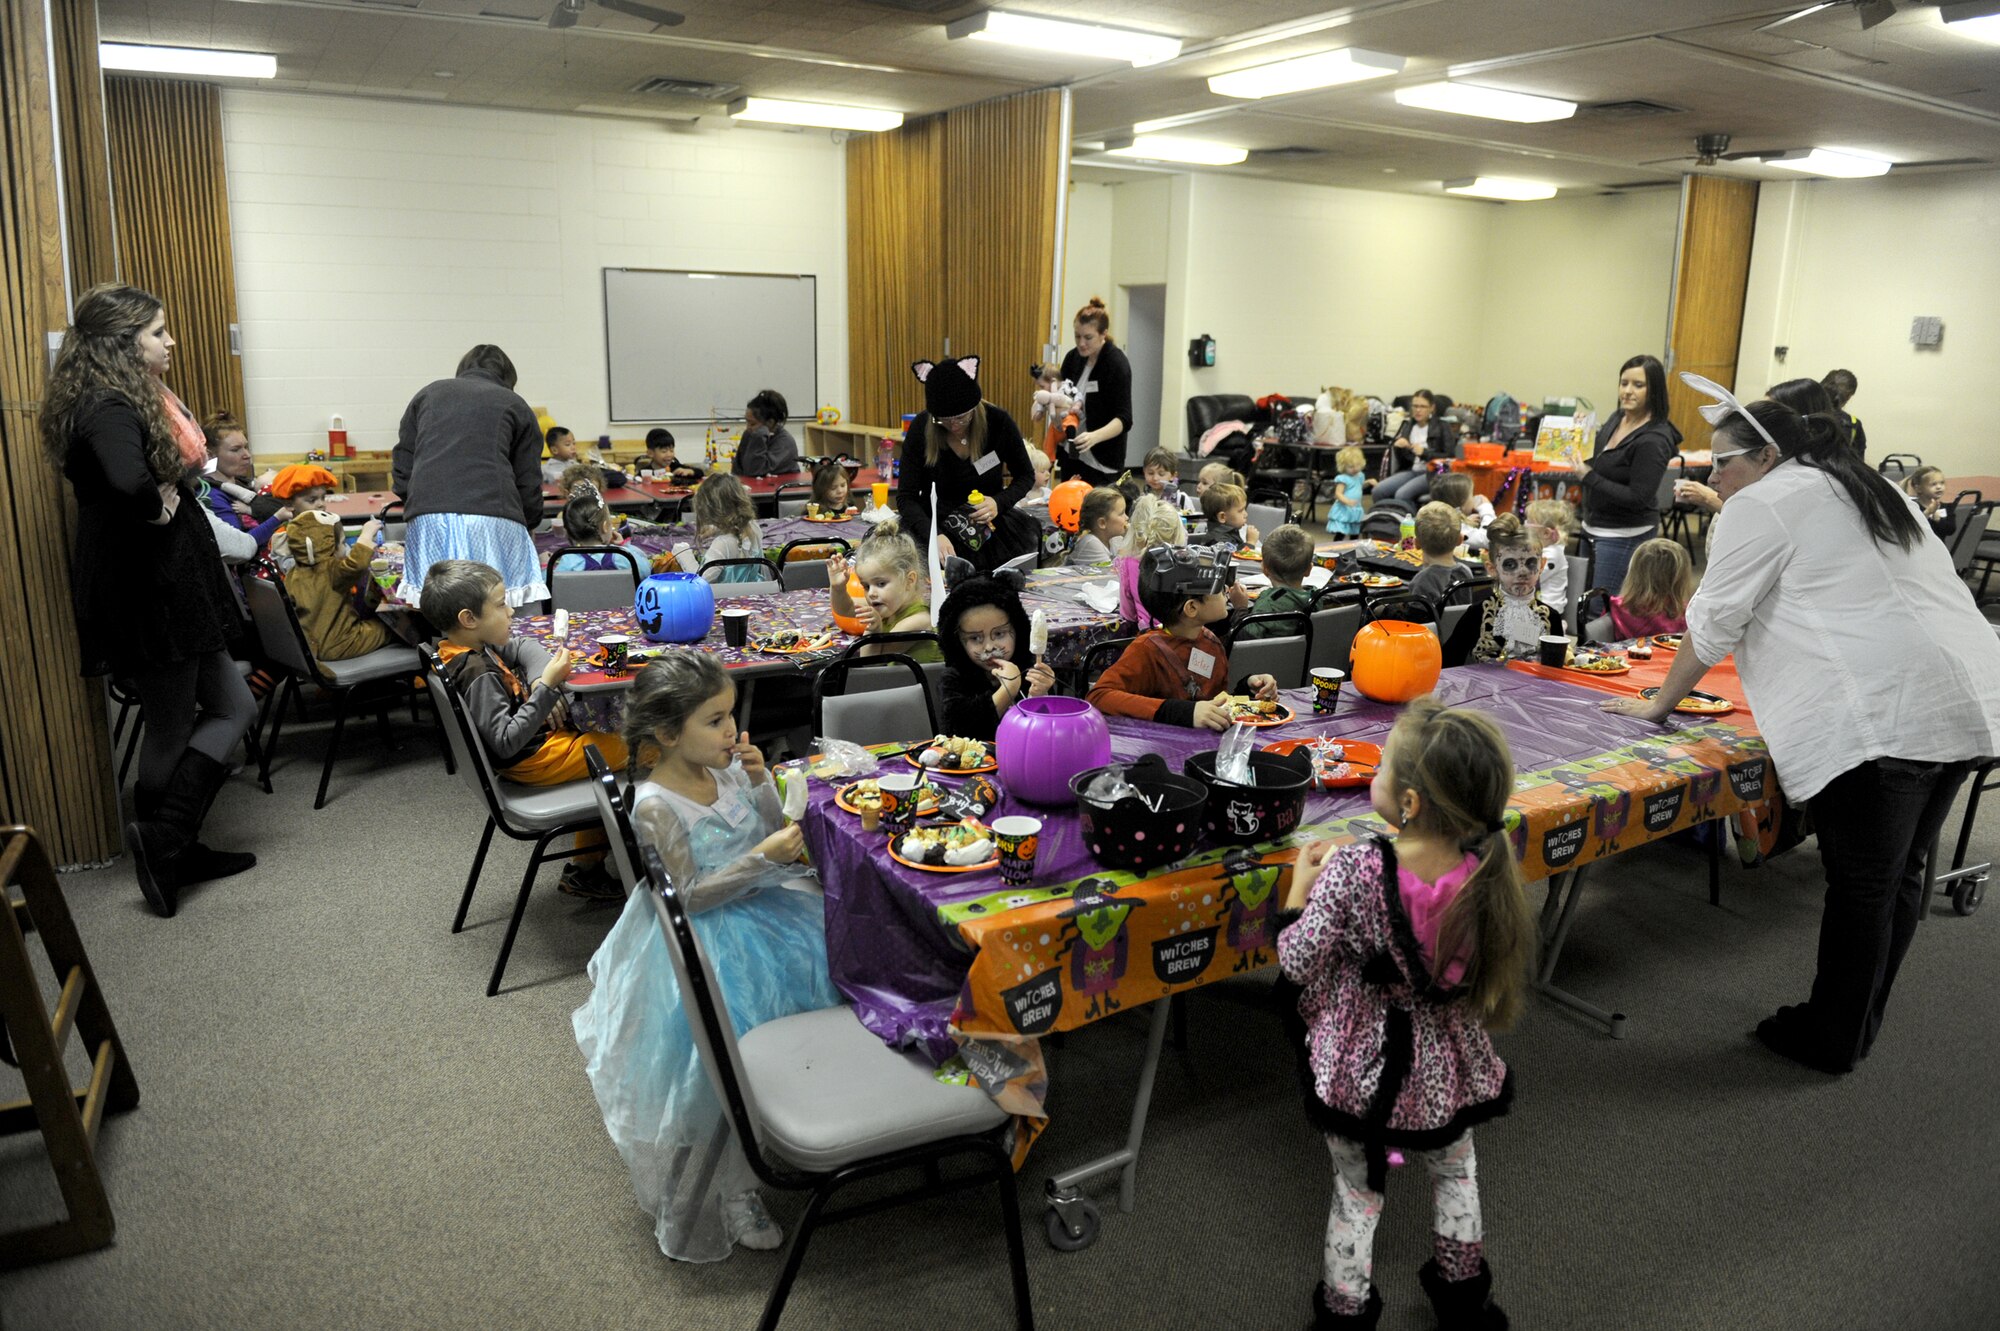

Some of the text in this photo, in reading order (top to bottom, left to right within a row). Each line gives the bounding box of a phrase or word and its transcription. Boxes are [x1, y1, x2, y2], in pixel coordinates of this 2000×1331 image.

[1649, 794, 1680, 814] WITCHES
[1650, 809, 1673, 824] BREW
[1547, 827, 1582, 848] WITCHES
[1551, 843, 1576, 859] BREW
[1160, 936, 1210, 961] WITCHES
[1167, 955, 1201, 975] BREW
[1014, 981, 1057, 1014] WITCHES
[1022, 1003, 1052, 1028] BREW
